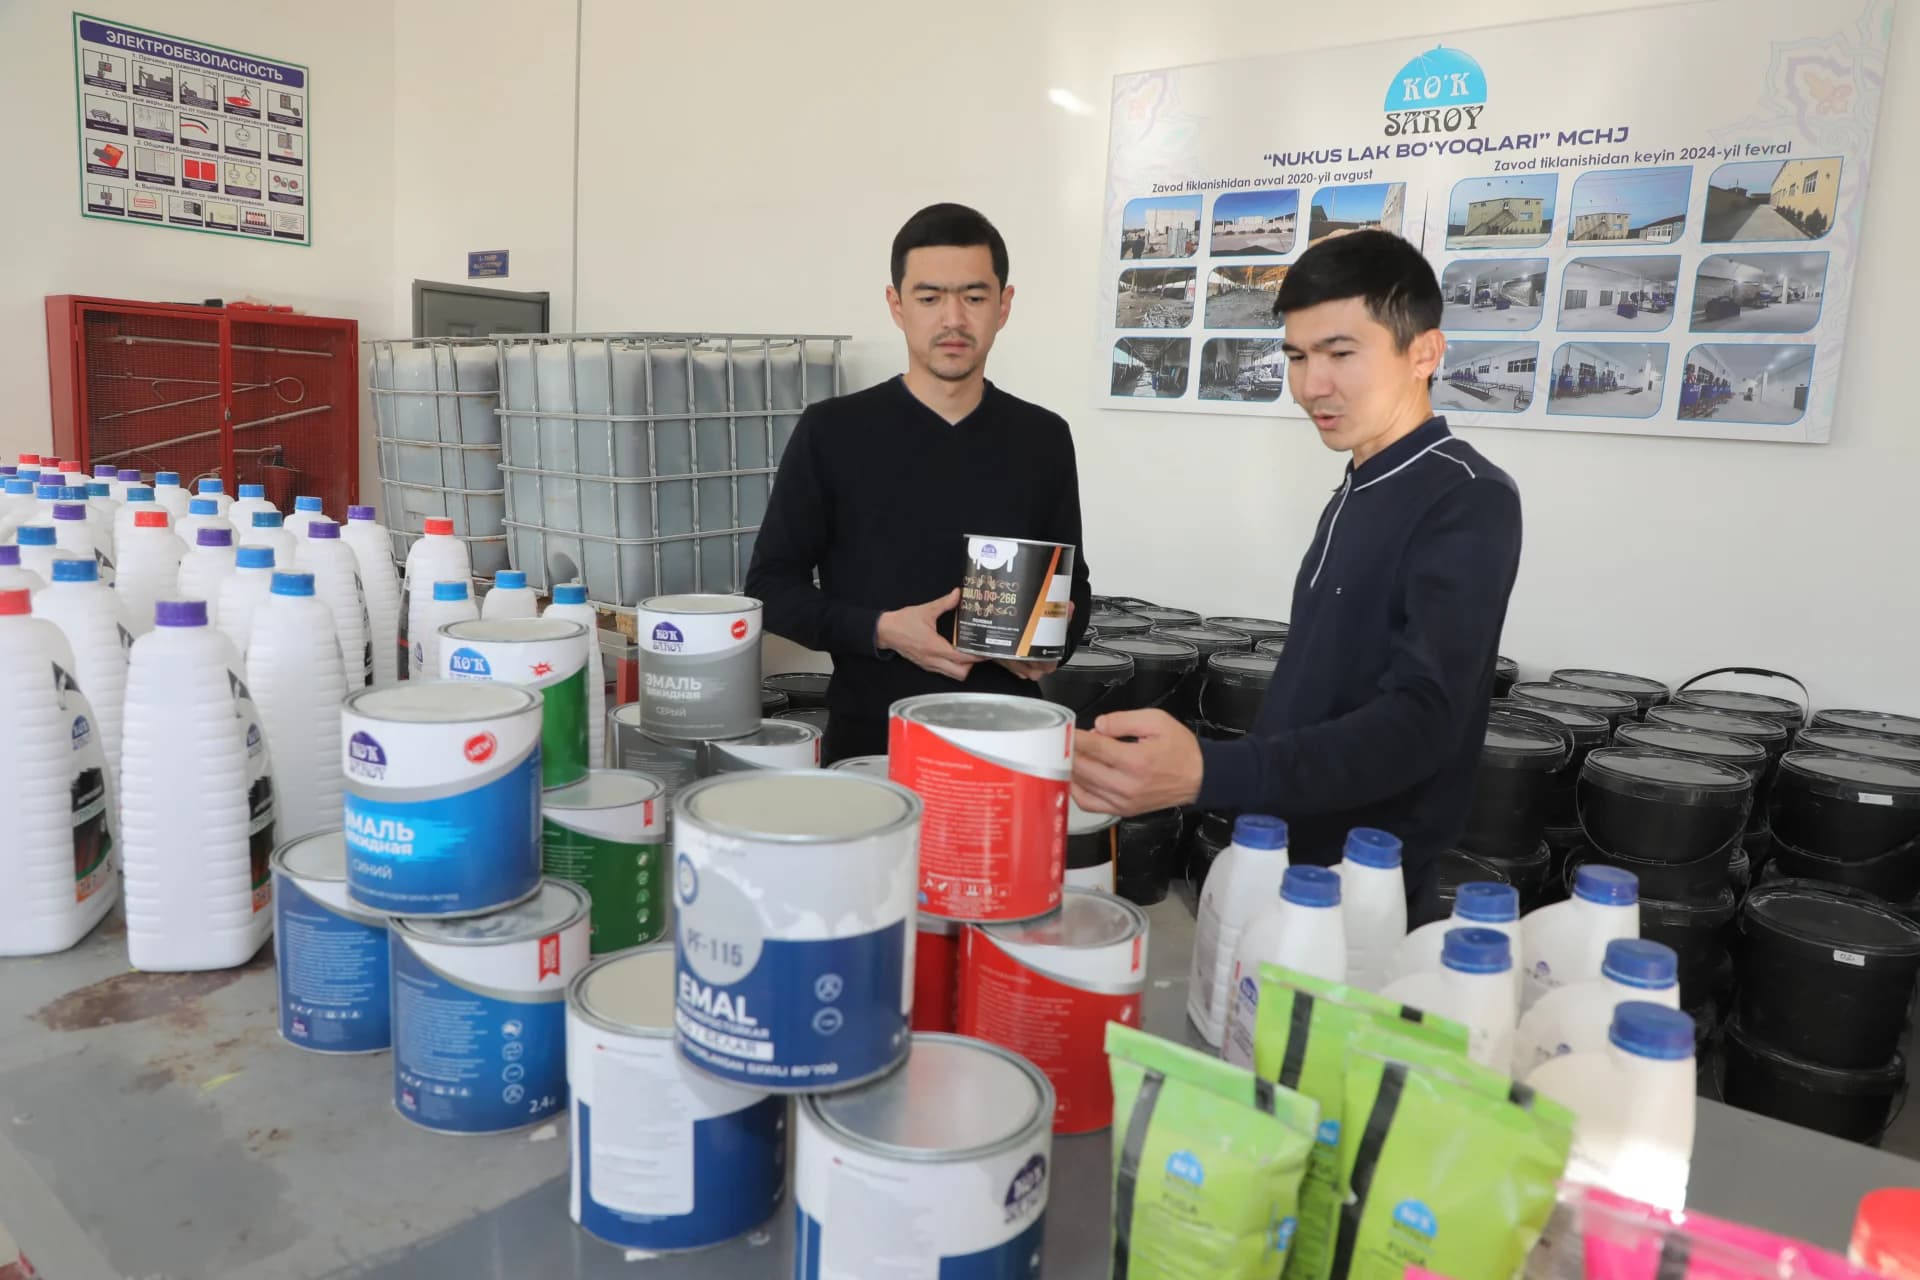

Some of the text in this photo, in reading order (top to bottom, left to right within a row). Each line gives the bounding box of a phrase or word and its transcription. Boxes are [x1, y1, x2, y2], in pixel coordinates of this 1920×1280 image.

[106, 30, 283, 81] ЭЛЕКТРОБЕЗОПАСНОСТЬ
[1402, 72, 1470, 102] KO'K
[1384, 105, 1484, 137] SAROY
[1347, 145, 1390, 162] LAK
[1557, 126, 1629, 146] MCHJ
[1494, 141, 1792, 172] Zavod tiklanishidan keyin 2024-yil fevral
[1152, 168, 1373, 193] Zavod tiklanishidan avval 2020-yil avgust
[984, 590, 1017, 604] ПФ-266
[645, 673, 703, 691] ЭМАЛЬ
[655, 705, 687, 717] СЕРЫЙ
[468, 739, 492, 758] NEW
[353, 858, 393, 881] СИНИЙ
[687, 928, 743, 968] PF-115
[680, 971, 758, 1027] EMAL
